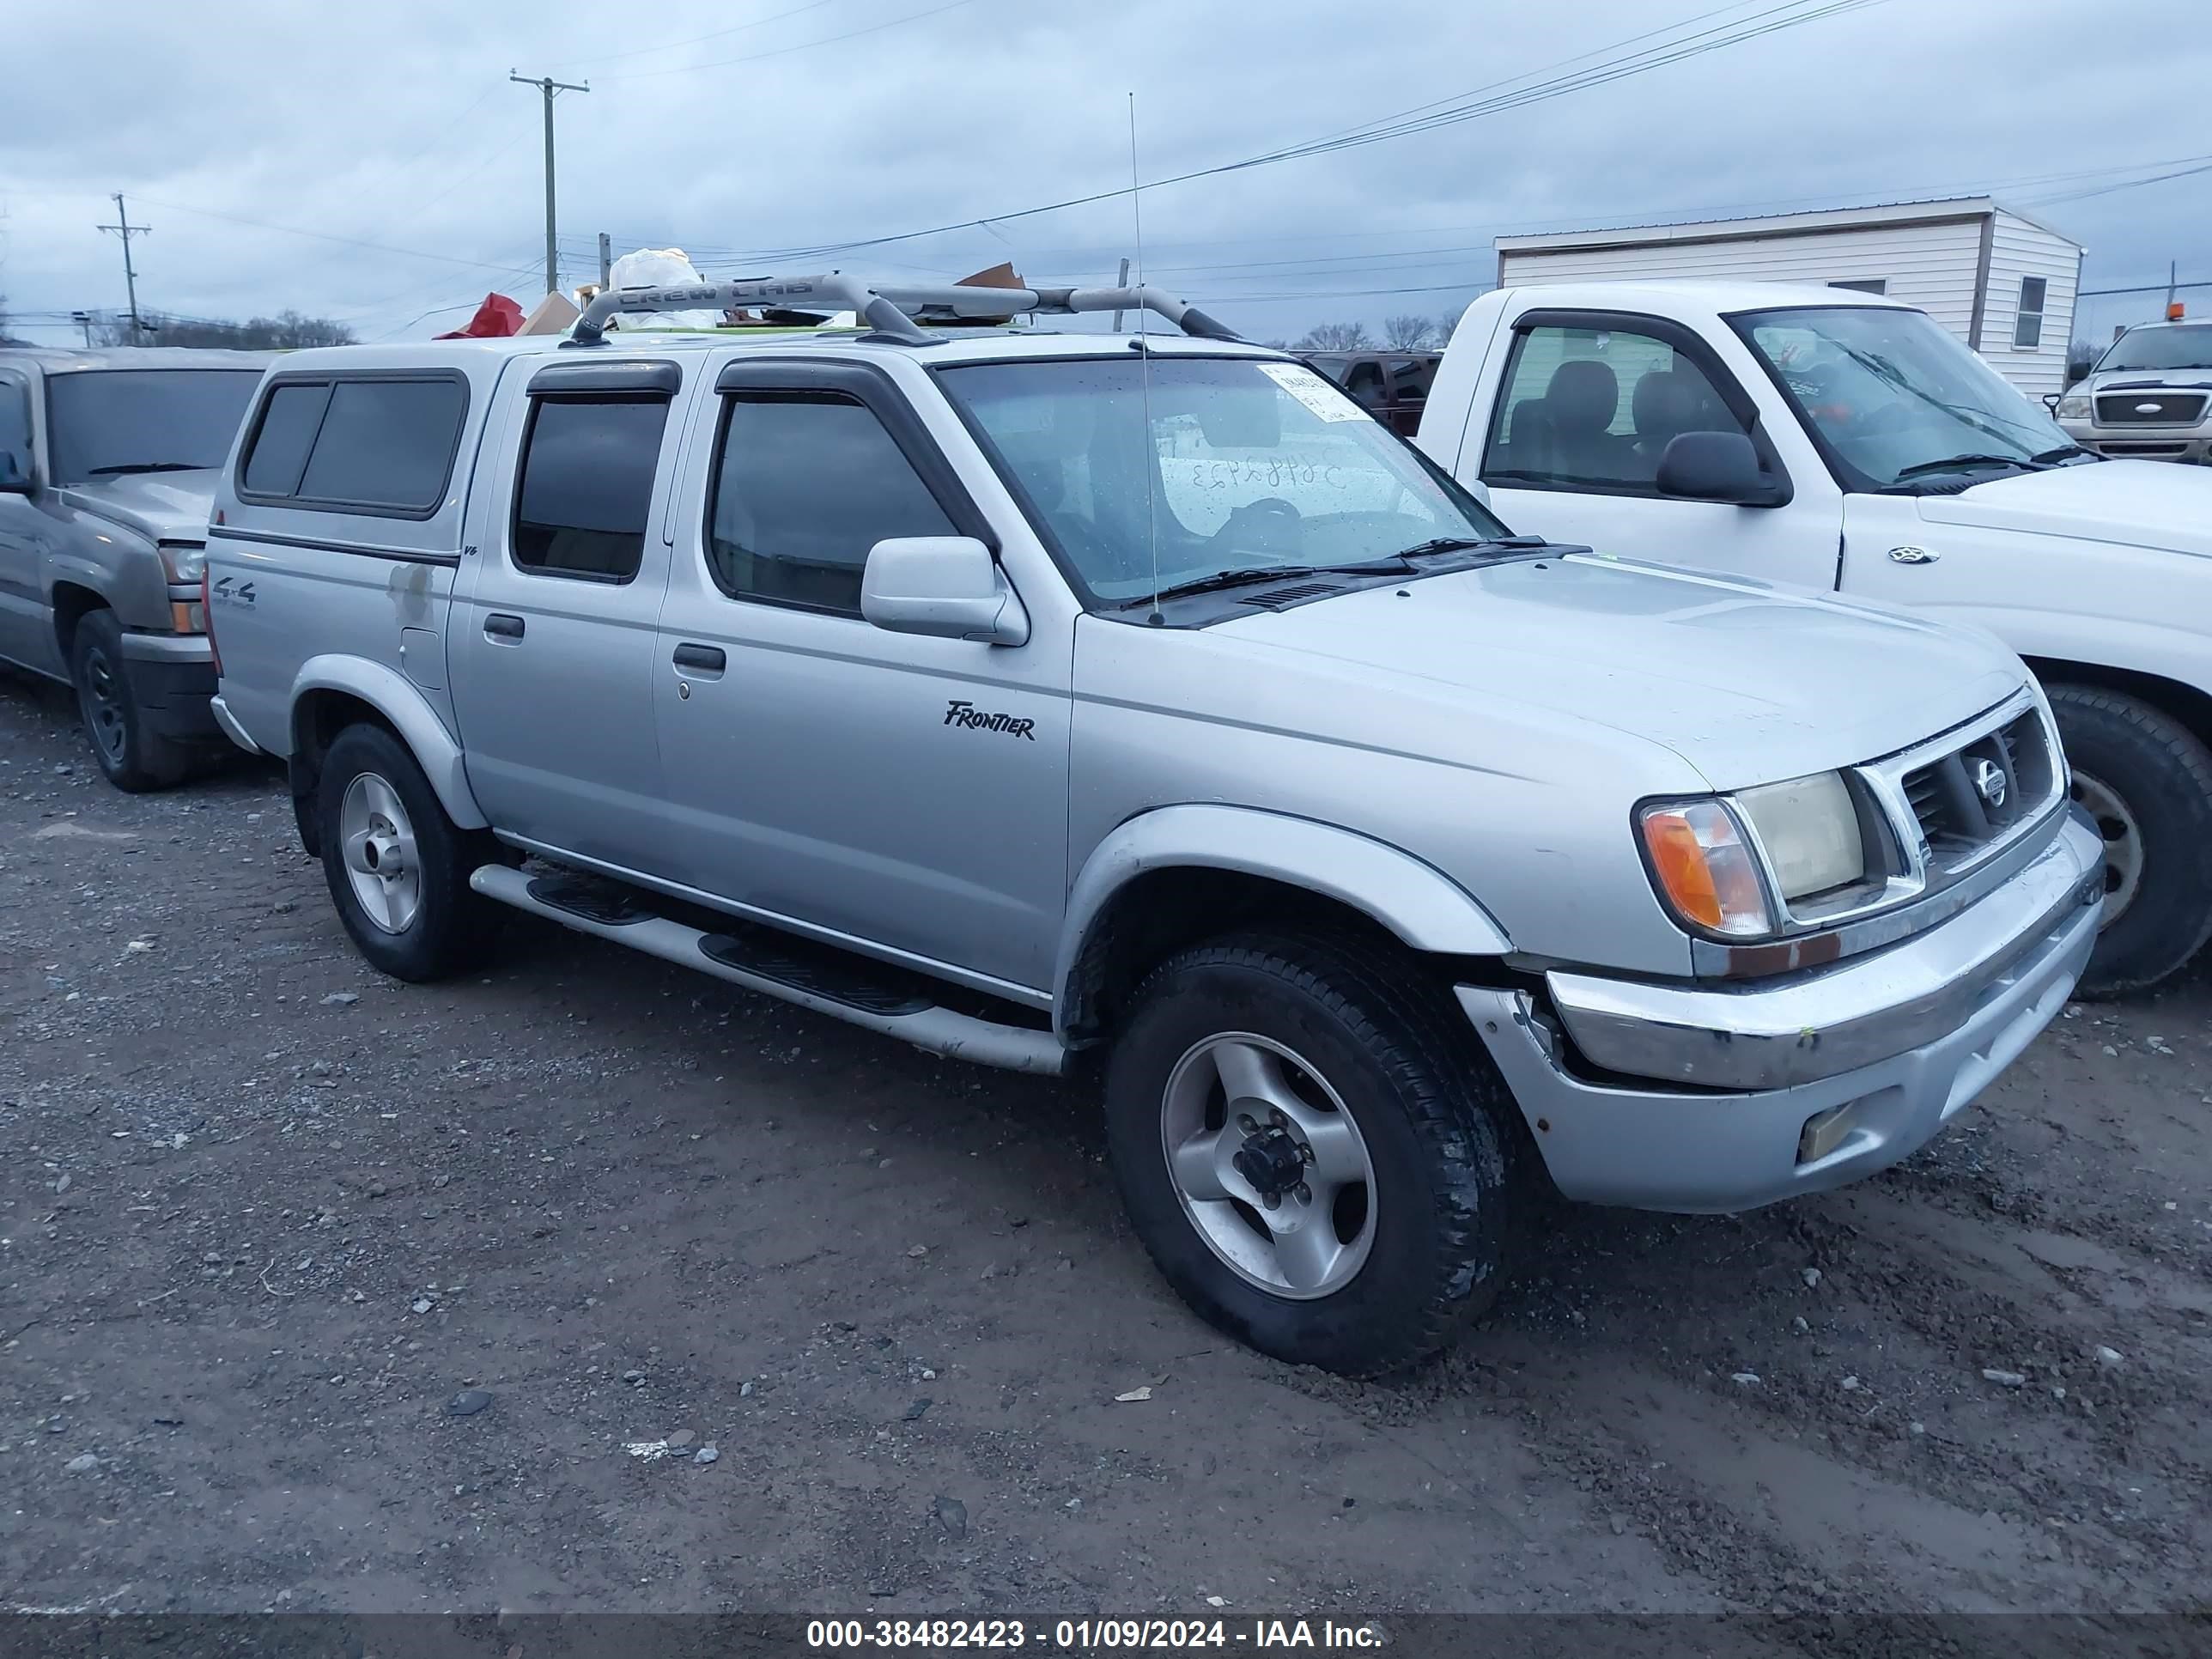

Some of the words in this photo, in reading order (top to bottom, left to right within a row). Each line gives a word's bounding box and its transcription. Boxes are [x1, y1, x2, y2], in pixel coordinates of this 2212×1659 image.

[619, 288, 717, 305] CREW
[732, 281, 813, 297] CAB
[464, 545, 478, 556] V6
